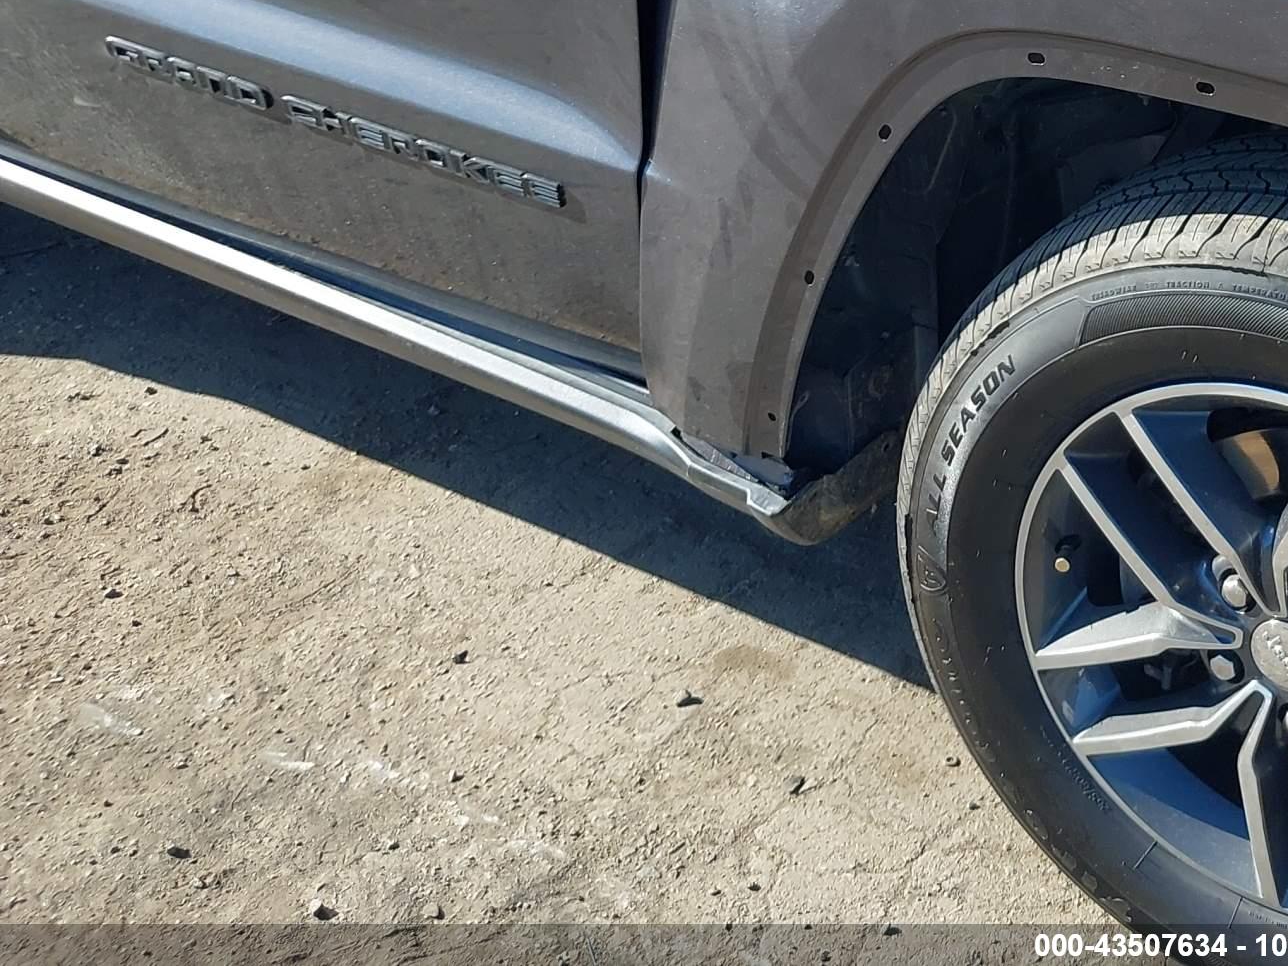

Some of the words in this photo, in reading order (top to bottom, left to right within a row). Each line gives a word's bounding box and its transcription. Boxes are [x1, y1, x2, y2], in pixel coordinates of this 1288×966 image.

[104, 35, 275, 110] GRAND
[279, 94, 568, 209] CHEROKEE
[940, 354, 1017, 466] SEASON
